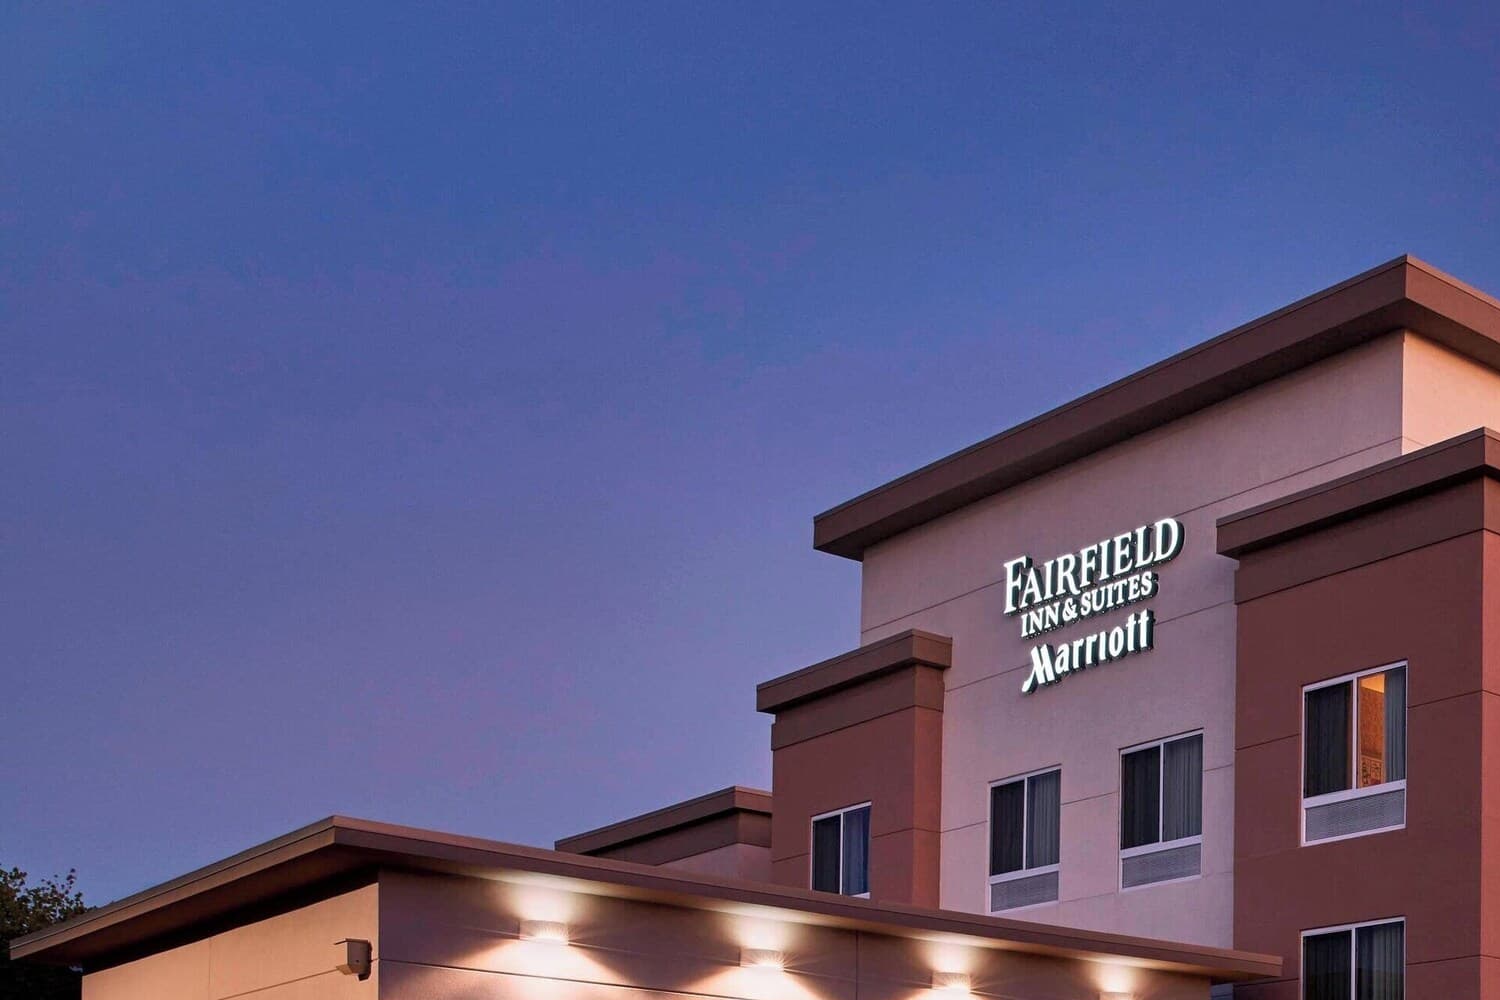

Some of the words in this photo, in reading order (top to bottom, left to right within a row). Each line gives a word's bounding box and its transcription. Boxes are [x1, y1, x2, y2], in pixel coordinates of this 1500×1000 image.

[1003, 517, 1183, 615] FAIRFIELD
[1020, 602, 1061, 638] INN
[1062, 597, 1079, 623] &
[1080, 571, 1154, 617] SUITES
[1021, 607, 1151, 693] Marriott
